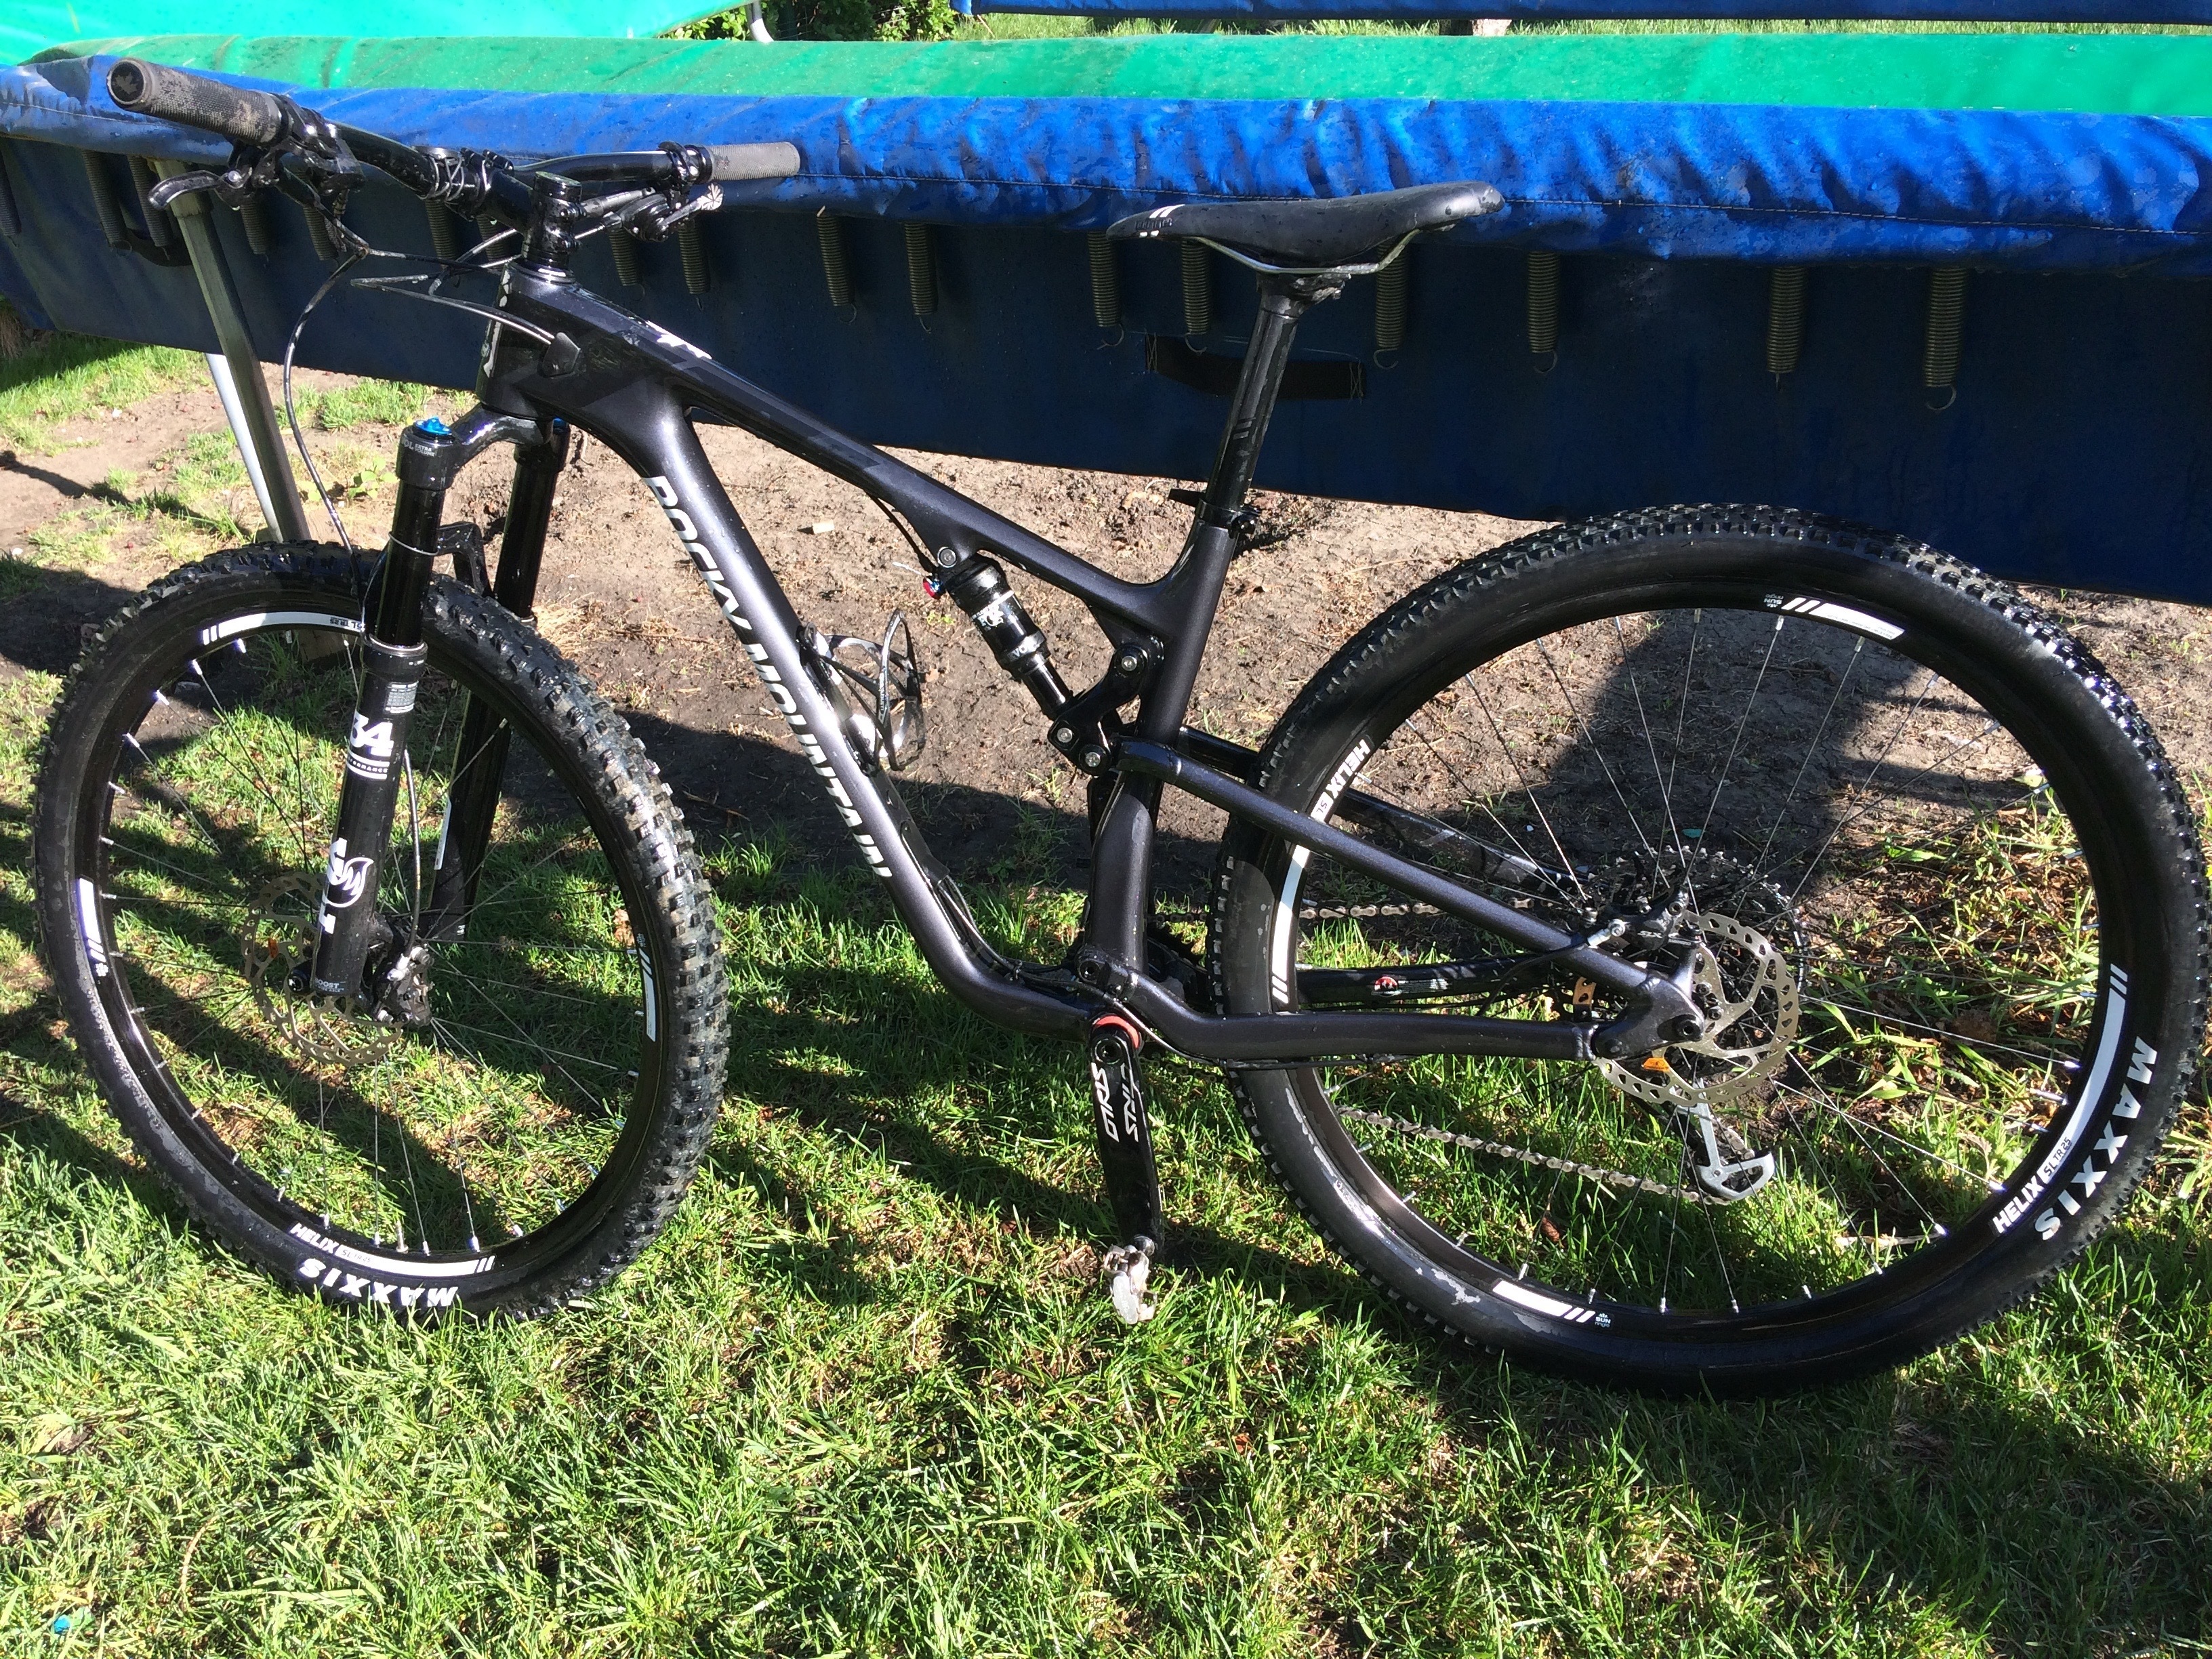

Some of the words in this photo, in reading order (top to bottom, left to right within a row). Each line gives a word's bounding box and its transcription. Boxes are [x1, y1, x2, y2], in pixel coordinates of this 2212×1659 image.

[350, 710, 394, 757] 34
[1326, 739, 1370, 799] HELIX
[1316, 800, 1327, 813] SL
[1637, 930, 1663, 939] SLX
[2034, 1036, 2158, 1240] MAXXIS
[1992, 1174, 2045, 1233] HELIX
[2043, 1162, 2059, 1177] SL
[2053, 1149, 2066, 1161] TR
[2061, 1136, 2072, 1150] 25
[289, 1222, 339, 1254] HELIX
[298, 1258, 459, 1307] MAXXIS
